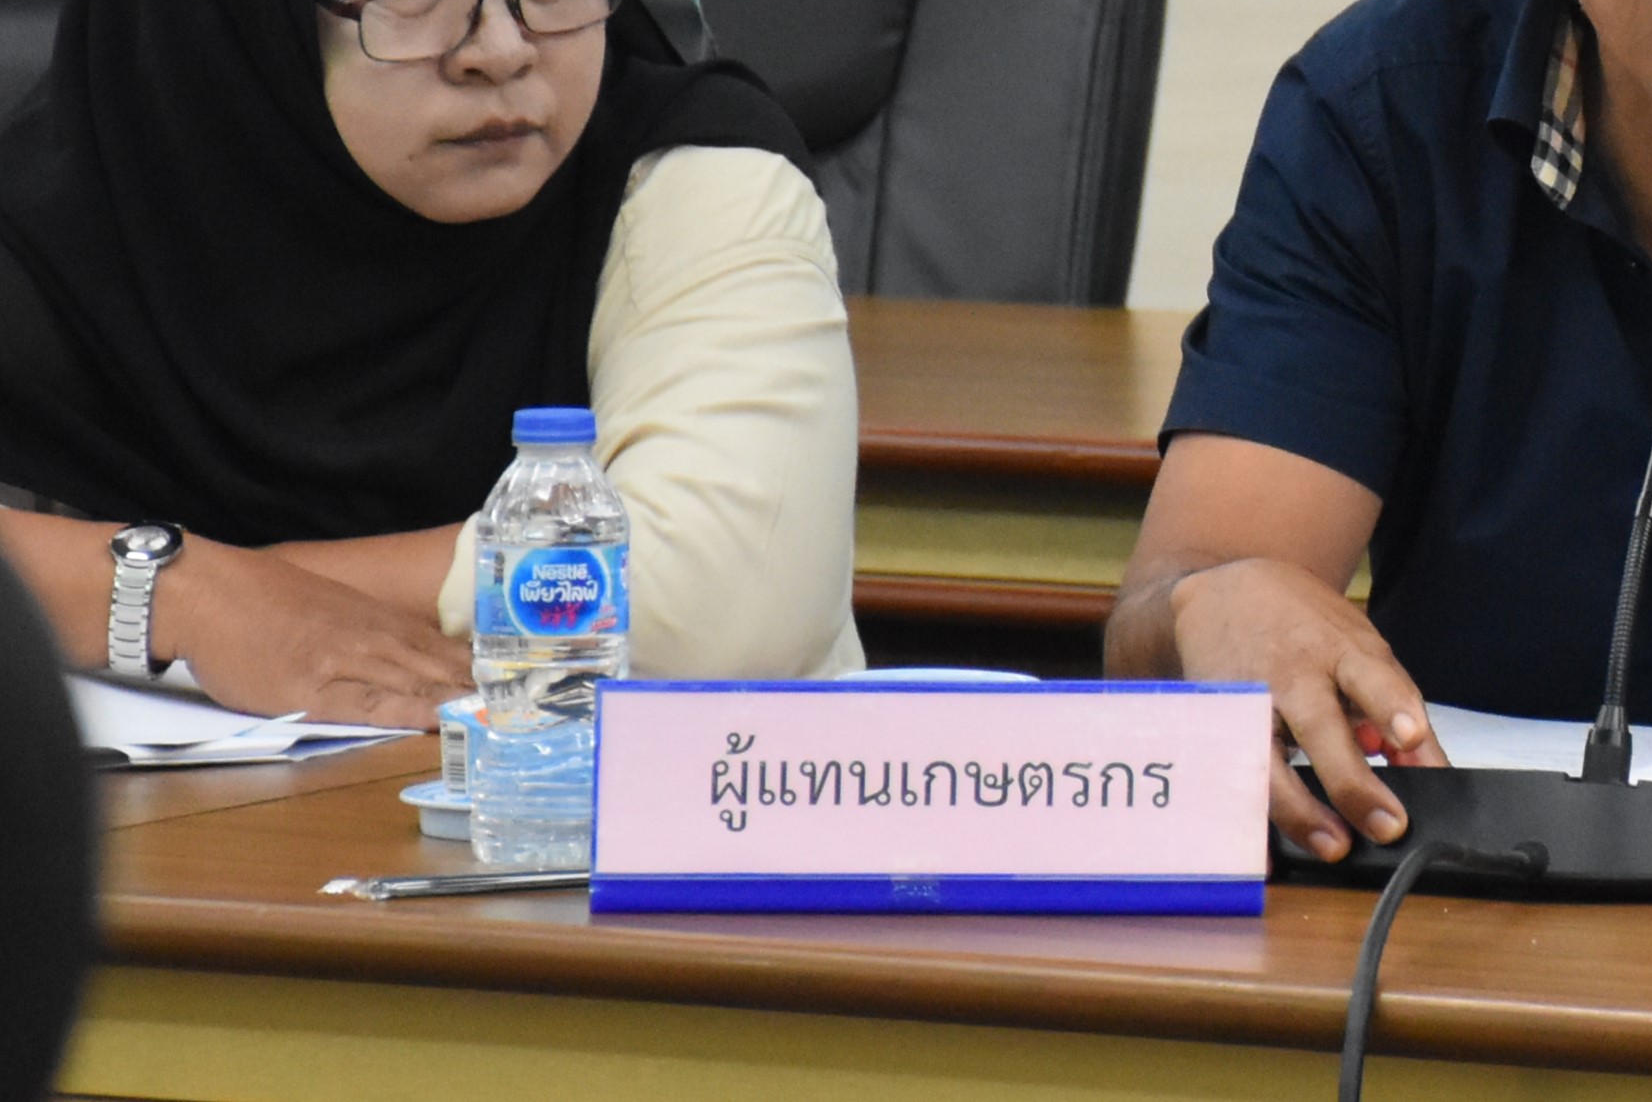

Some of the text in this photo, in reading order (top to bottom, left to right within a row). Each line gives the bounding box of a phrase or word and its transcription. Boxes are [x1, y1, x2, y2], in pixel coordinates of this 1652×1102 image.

[710, 732, 1173, 832] ผู้แทนเกษตรกร
